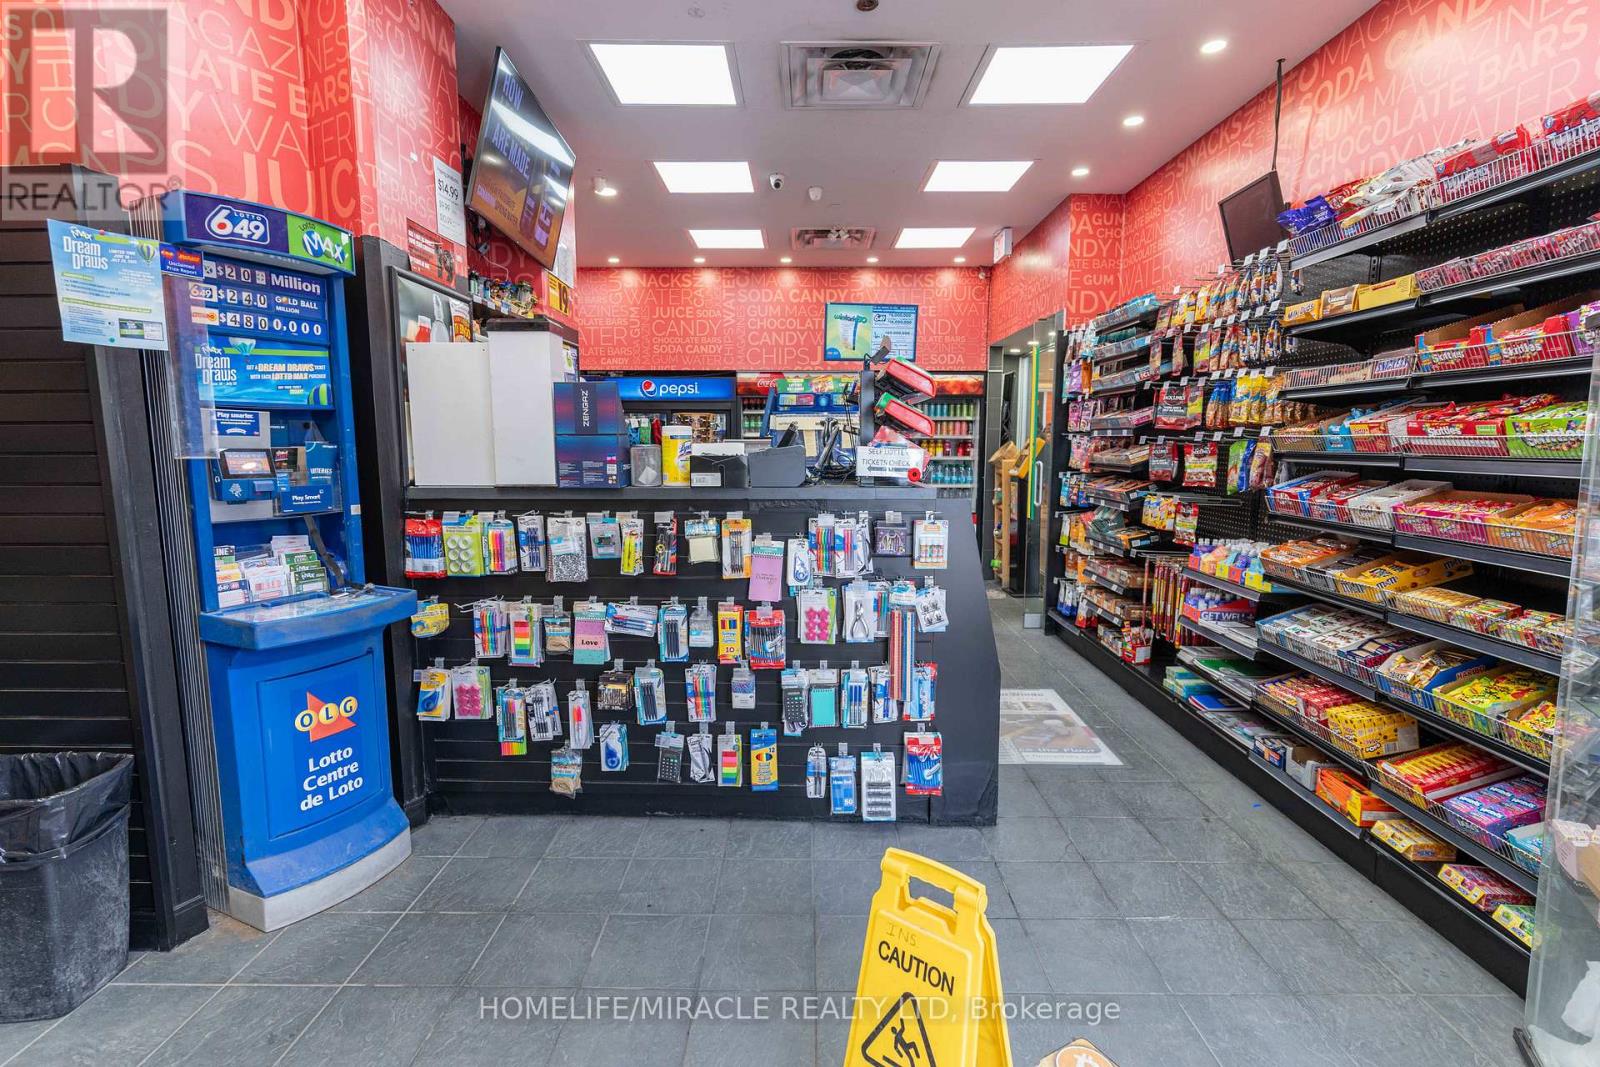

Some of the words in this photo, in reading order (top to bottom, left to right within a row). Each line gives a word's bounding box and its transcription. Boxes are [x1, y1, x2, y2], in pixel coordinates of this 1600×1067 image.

[502, 73, 525, 112] HOW
[1305, 72, 1467, 178] CHOCOLATE
[1476, 6, 1589, 93] BARS
[491, 122, 508, 158] ARE
[507, 141, 532, 182] MADE
[233, 211, 262, 222] LOTTO
[63, 235, 101, 256] Dream
[72, 253, 109, 270] Draws
[270, 273, 321, 296] Million
[623, 273, 693, 288] SNACKS
[866, 273, 935, 288] SNACKS
[1083, 274, 1114, 286] GUM
[623, 288, 695, 305] WATER
[737, 288, 784, 303] SODA
[788, 288, 848, 303] CANDY
[300, 299, 319, 311] BALL
[652, 306, 694, 319] JUICE
[696, 309, 722, 318] SODA
[747, 305, 781, 317] GUM
[652, 319, 722, 337] CANDY
[653, 336, 699, 344] CHOCOLATE
[747, 332, 807, 346] CANDY
[653, 345, 684, 354] SODA
[685, 345, 722, 354] CANDY
[746, 347, 809, 366] CHIPS
[1502, 341, 1543, 358] Skittles
[195, 352, 231, 370] Dream
[258, 363, 286, 372] DREAM
[287, 363, 315, 372] DRAWS
[600, 357, 629, 365] CANDY
[930, 354, 965, 365] SODA
[202, 368, 237, 385] Draws
[659, 381, 700, 397] pepsi
[1427, 425, 1462, 437] Skittles
[1201, 611, 1221, 620] GET
[308, 746, 353, 772] Lotto
[303, 760, 359, 792] Centre
[300, 794, 324, 812] de
[328, 776, 364, 800] Loto
[877, 940, 955, 997] CAUTION
